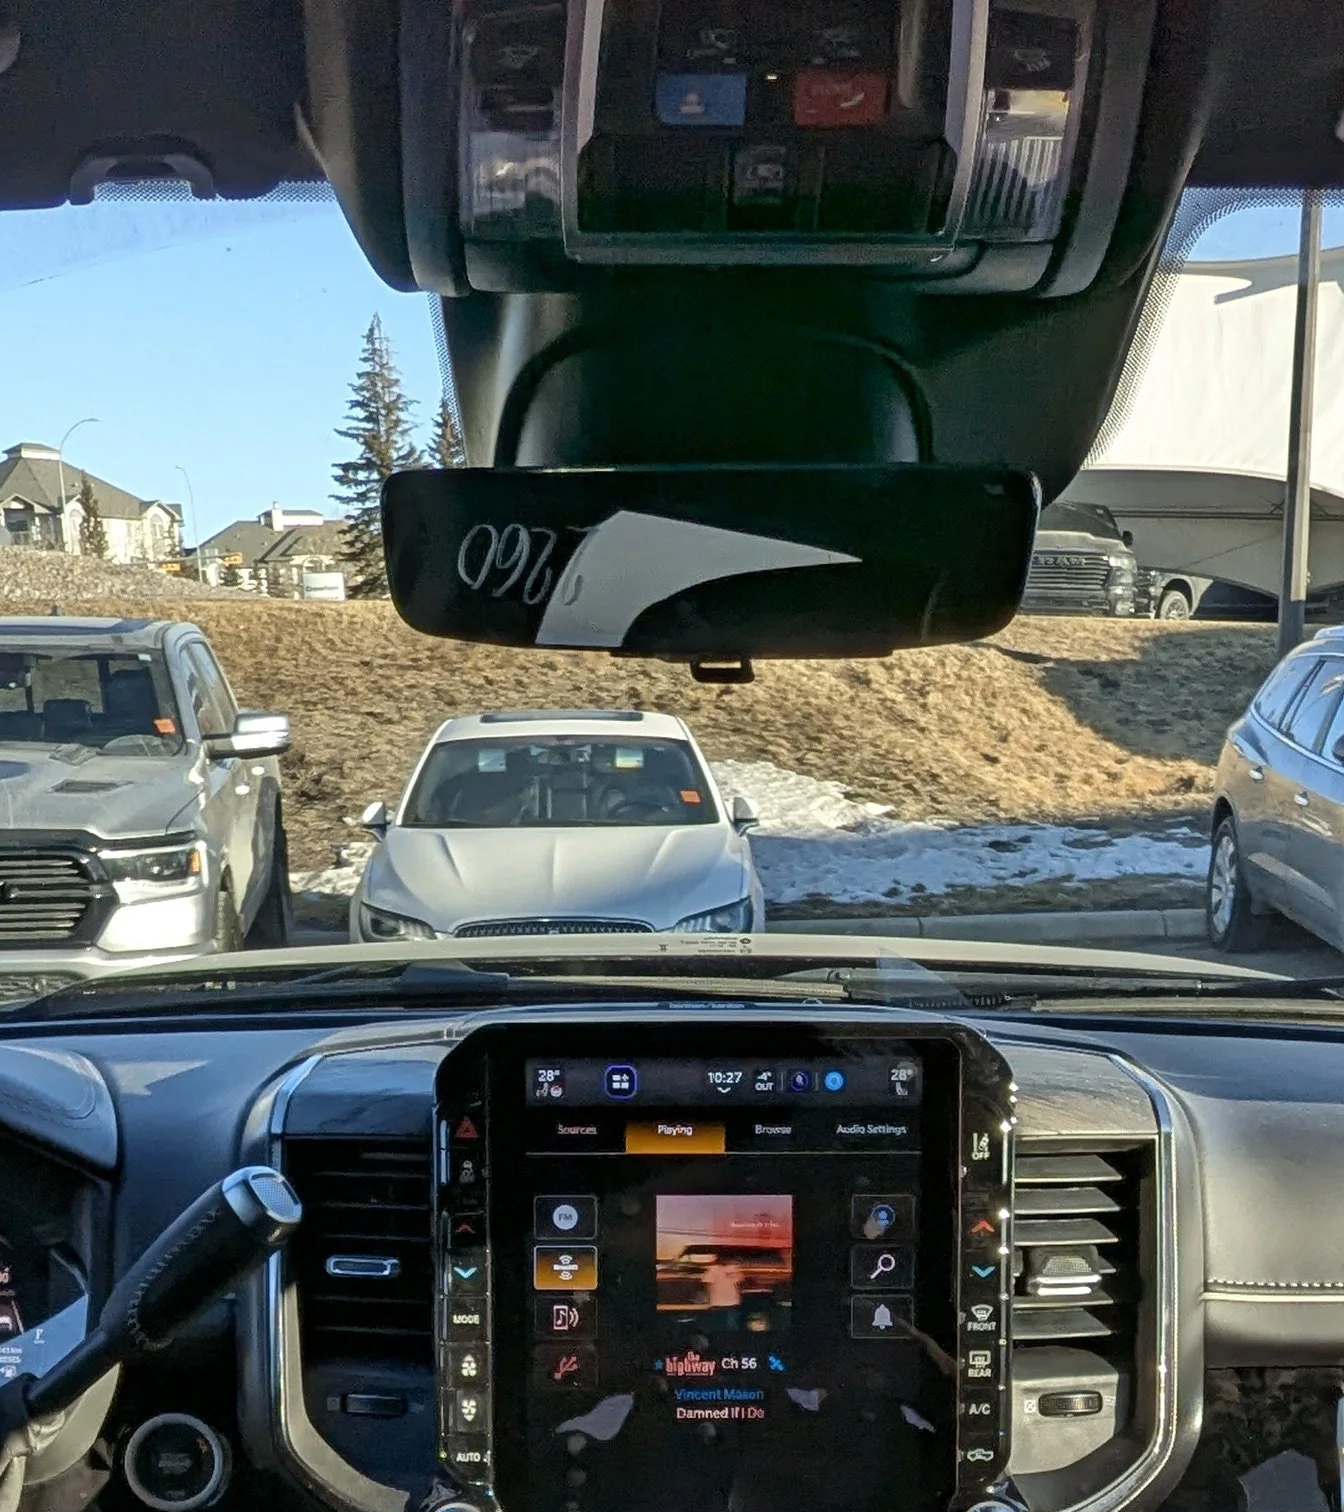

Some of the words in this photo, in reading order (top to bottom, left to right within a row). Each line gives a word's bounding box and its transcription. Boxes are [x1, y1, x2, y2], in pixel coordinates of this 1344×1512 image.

[707, 1071, 743, 1084] 10:27
[755, 1081, 775, 1091] OUT
[557, 1123, 598, 1136] Sources
[657, 1124, 693, 1137] Playing
[754, 1124, 792, 1136] Browse
[836, 1124, 865, 1135] Audio
[866, 1124, 907, 1137] Settings
[971, 1152, 991, 1160] OFF
[453, 1314, 480, 1325] MODE
[967, 1321, 996, 1332] FRONT
[666, 1356, 716, 1377] highway
[721, 1357, 739, 1369] Ch
[741, 1357, 758, 1370] 56
[968, 1368, 992, 1378] REAR
[674, 1388, 722, 1401] Vincent
[723, 1388, 765, 1401] Mason
[676, 1406, 729, 1419] Damned
[747, 1407, 765, 1419] Do
[969, 1403, 991, 1415] A/C
[456, 1452, 481, 1463] AUTO
